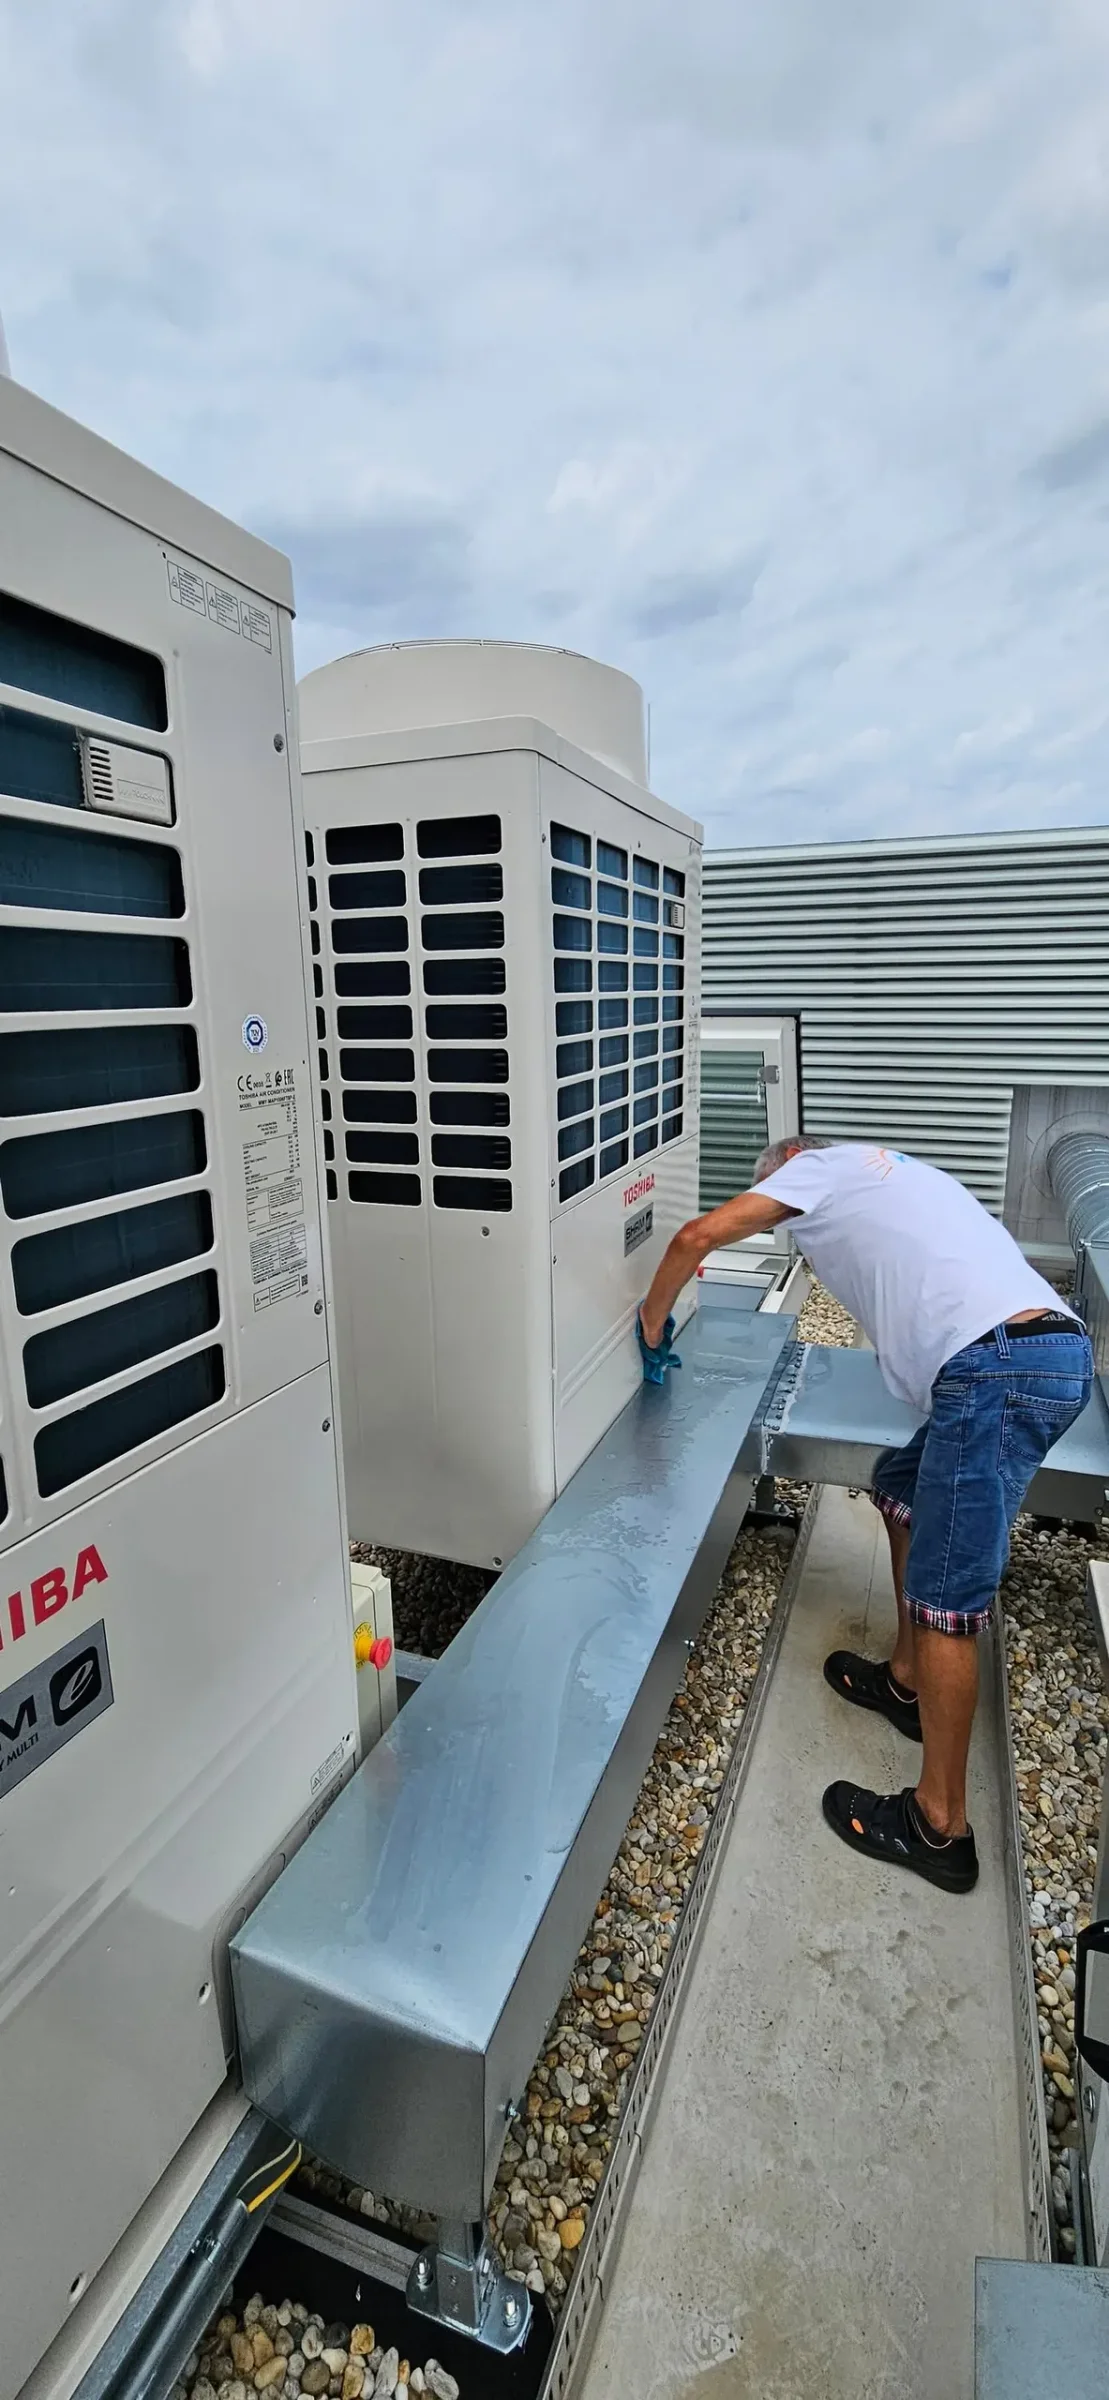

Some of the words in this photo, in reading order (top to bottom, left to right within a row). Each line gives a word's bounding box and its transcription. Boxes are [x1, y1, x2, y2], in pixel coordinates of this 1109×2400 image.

[239, 1093, 258, 1101] TOSHIBA
[267, 1087, 295, 1096] CONDITIONER
[623, 1173, 655, 1207] TOSHIBA
[0, 1544, 108, 1650] IBA
[6, 1732, 40, 1767] MULTI
